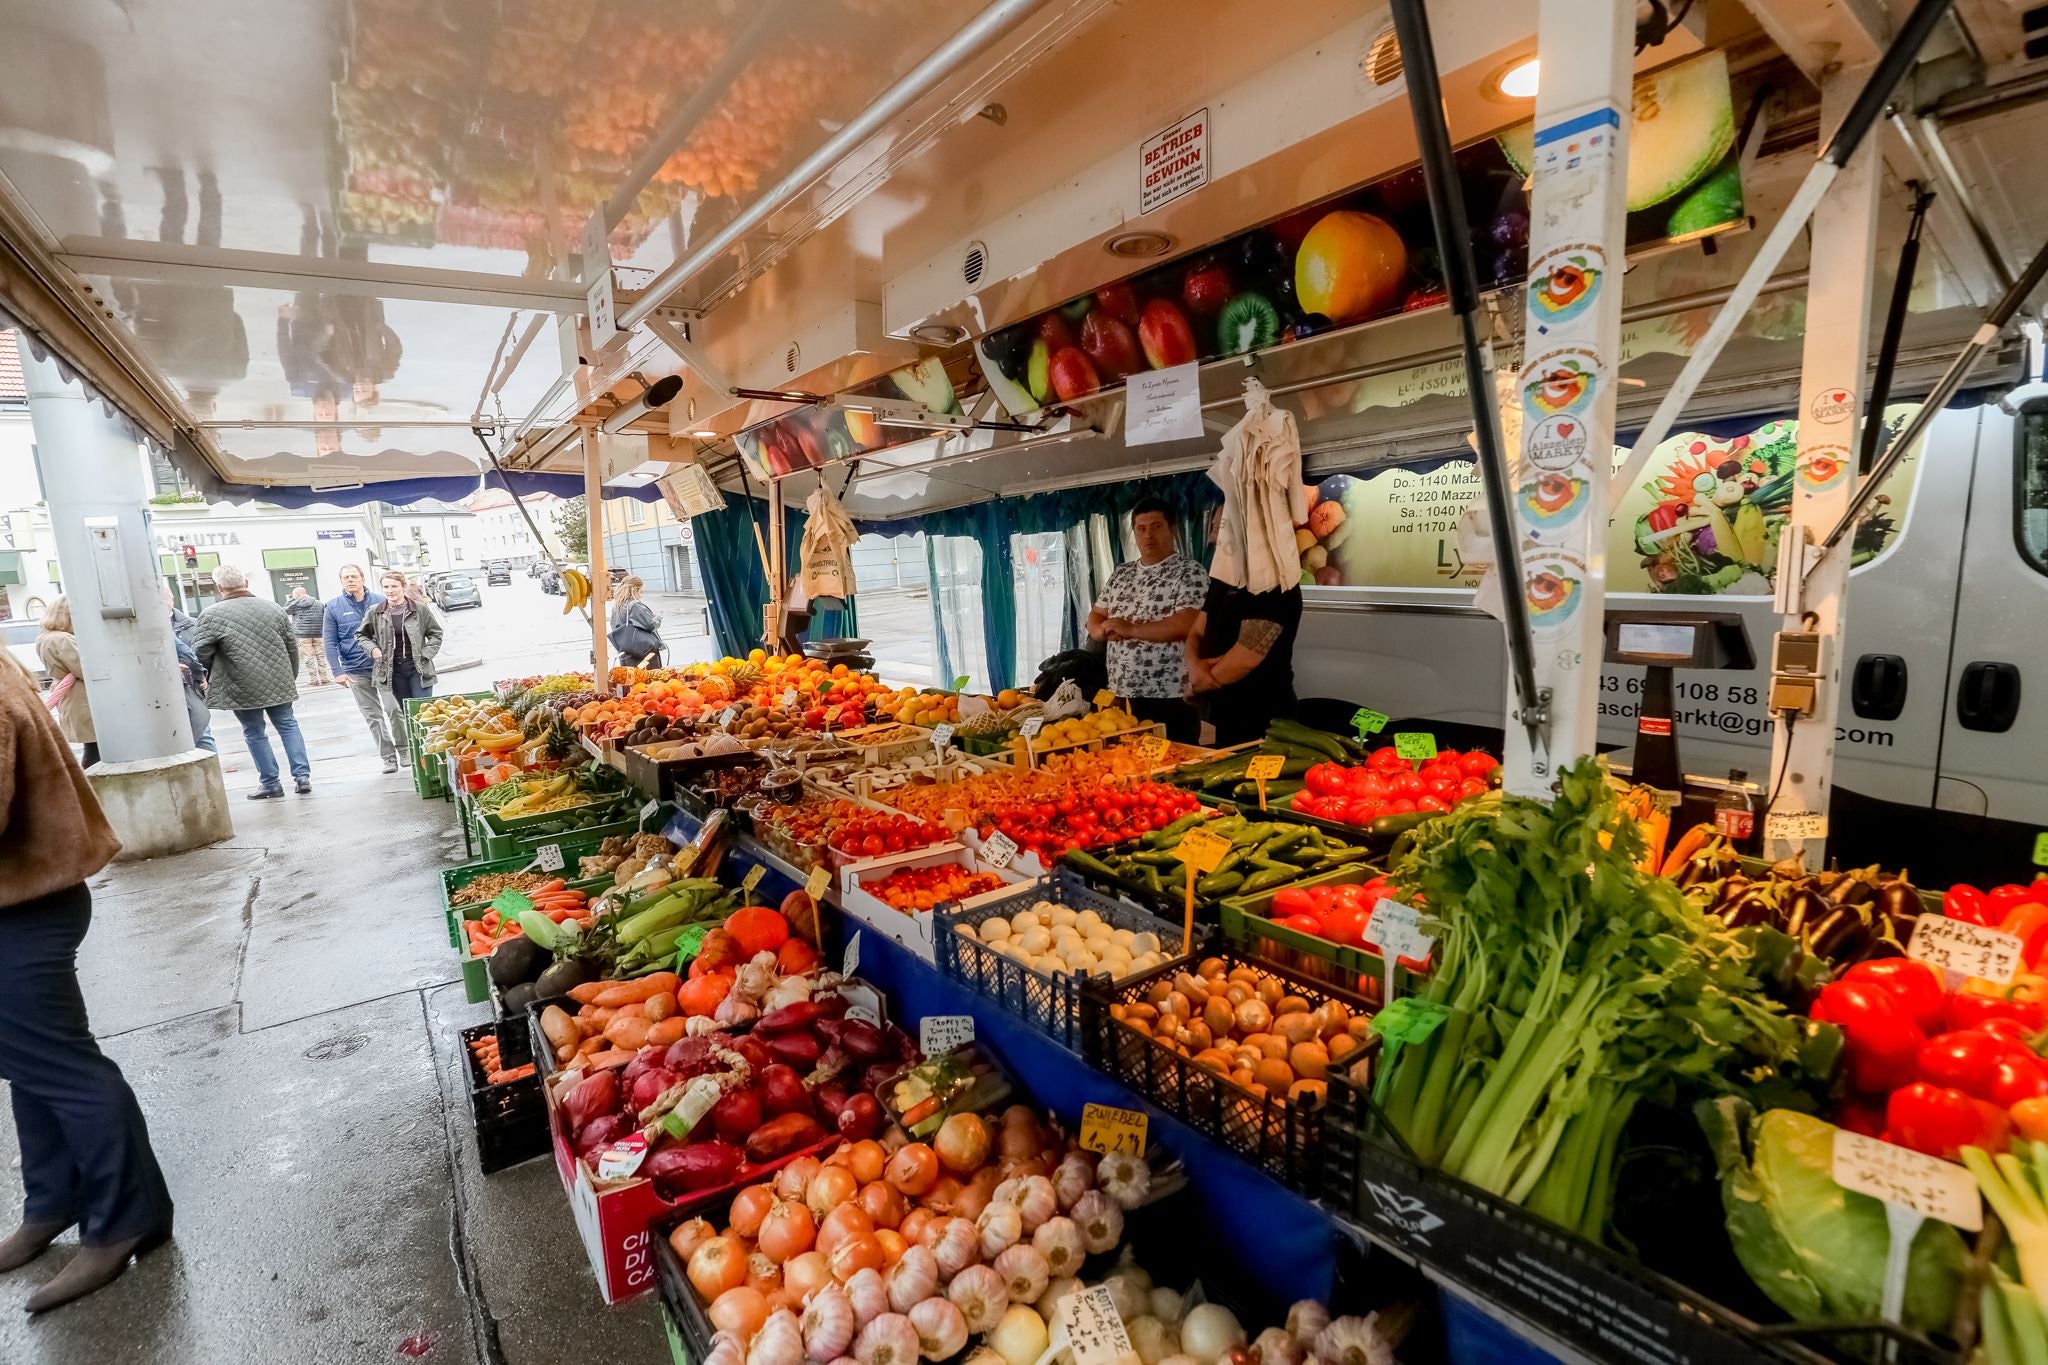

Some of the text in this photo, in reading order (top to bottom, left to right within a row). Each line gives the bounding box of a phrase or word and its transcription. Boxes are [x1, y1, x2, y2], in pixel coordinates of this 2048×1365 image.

[1144, 123, 1203, 166] BETRIEB
[1152, 144, 1193, 170] arbeitet ohne
[1145, 148, 1201, 188] GEWINN
[1544, 424, 1551, 439] I
[1532, 446, 1581, 460] MARKT
[1419, 476, 1447, 486] 1140
[1409, 491, 1438, 502] 1220
[1400, 507, 1422, 518] Sa.:
[1426, 505, 1456, 517] 1040
[1392, 521, 1413, 533] und
[1416, 521, 1446, 533] 1170
[1727, 686, 1758, 705] 58
[1922, 923, 1993, 948] PAPRIKA
[1086, 1104, 1145, 1128] ZWIEBEL
[1094, 1287, 1115, 1313] ROTE
